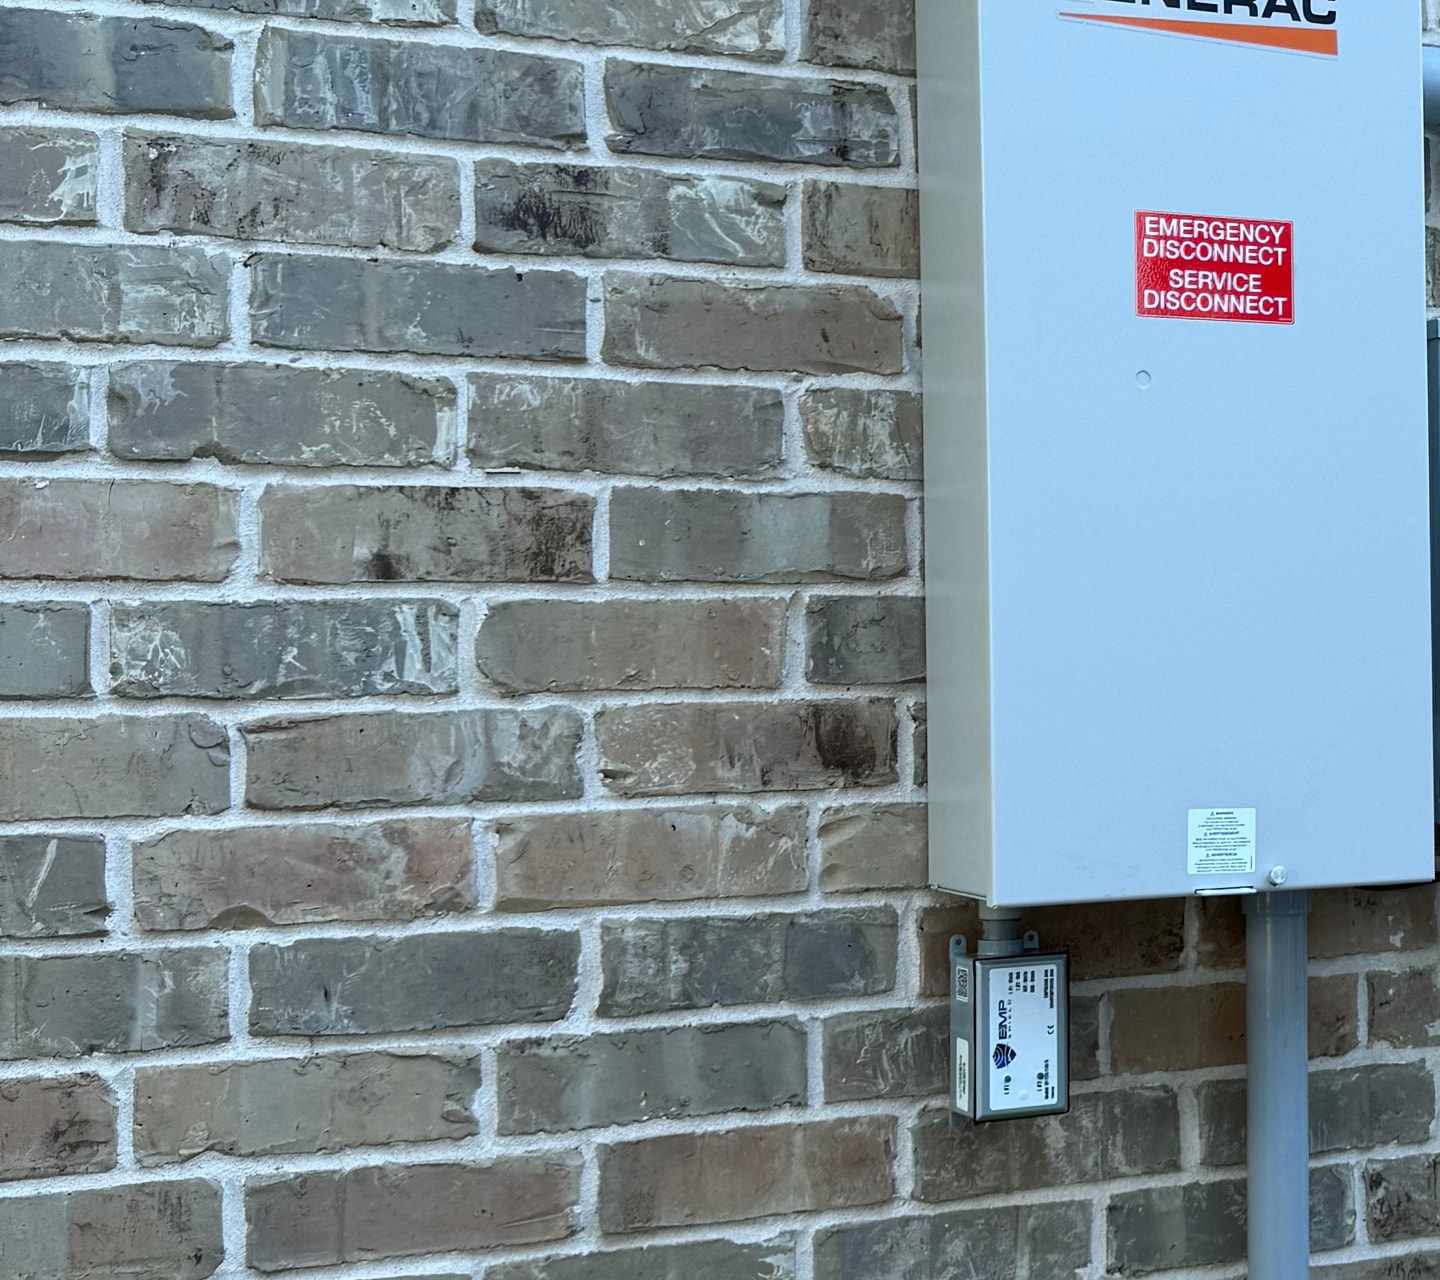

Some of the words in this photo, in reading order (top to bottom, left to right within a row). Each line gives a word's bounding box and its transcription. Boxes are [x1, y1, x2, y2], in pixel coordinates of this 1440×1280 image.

[1143, 215, 1286, 244] EMERGENCY
[1142, 238, 1288, 267] DISCONNECT
[1167, 268, 1263, 295] SERVICE
[1142, 288, 1289, 317] DISCONNECT
[998, 999, 1008, 1040] EMP
